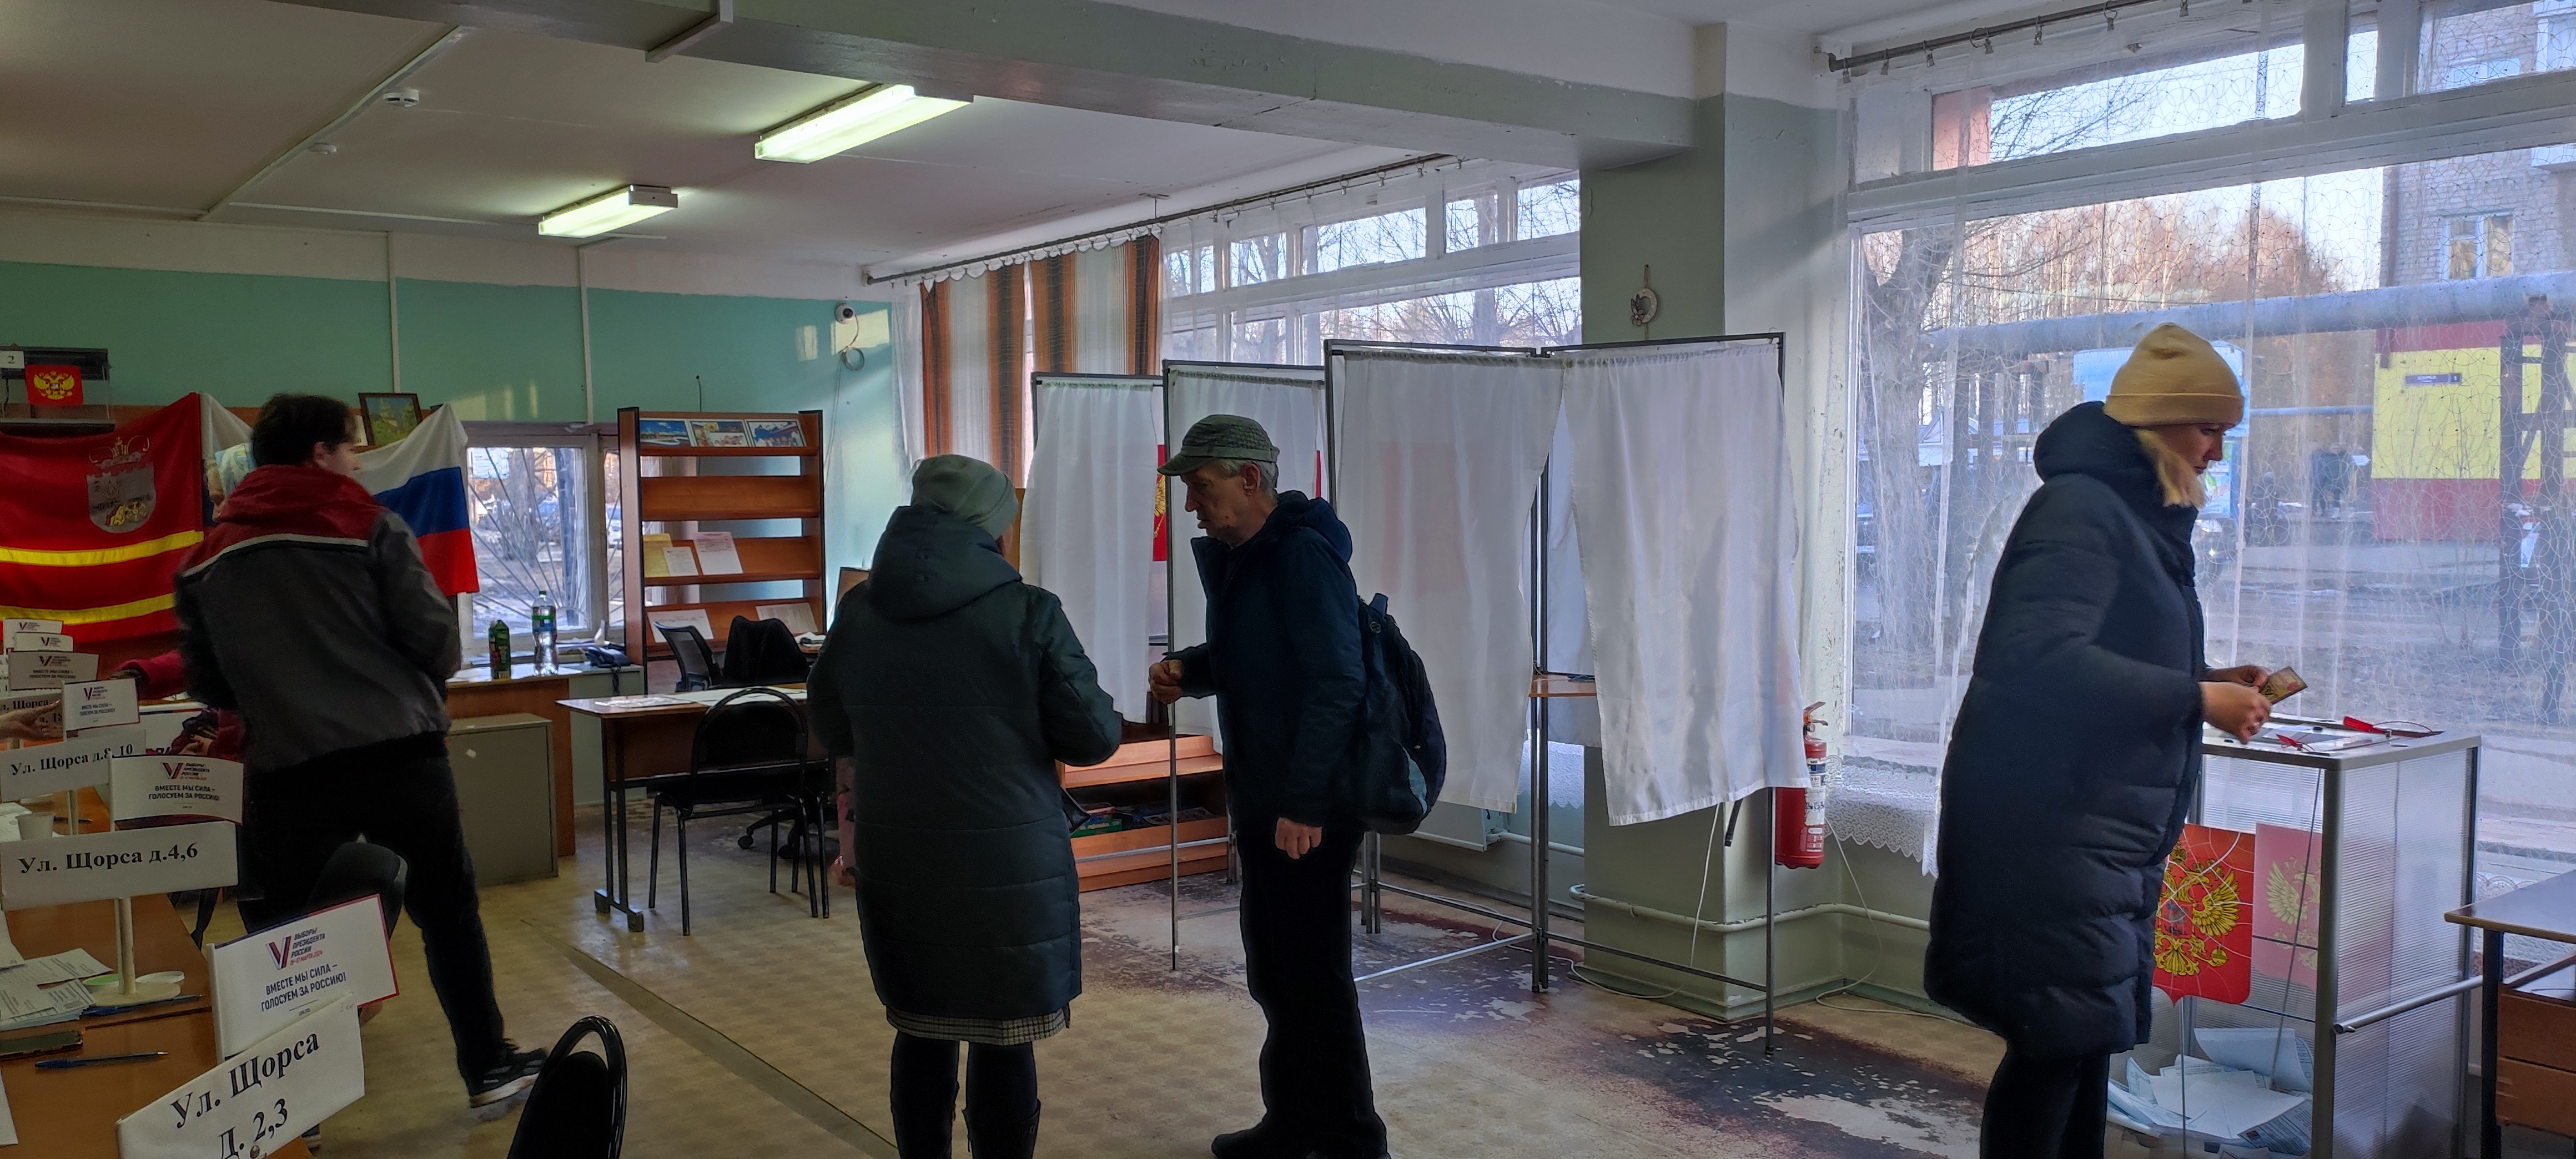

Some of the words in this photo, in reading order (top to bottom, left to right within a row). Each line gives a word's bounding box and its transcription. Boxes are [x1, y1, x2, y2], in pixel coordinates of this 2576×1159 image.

[8, 355, 15, 364] 2
[11, 763, 36, 775] Ул.
[41, 754, 88, 770] Щорса
[119, 744, 133, 756] 10
[18, 857, 57, 874] Ул.
[66, 851, 143, 870] Щорса
[149, 842, 198, 864] д.4,6
[292, 933, 325, 949] ПРЕЗИДЕНТА
[294, 927, 318, 940] ВЫБОРЫ
[291, 945, 312, 958] РОССИИ
[261, 989, 298, 1012] ГОЛОСУЕМ
[299, 985, 309, 996] ЗА
[310, 971, 346, 992] РОССИЮ!
[265, 976, 294, 995] ВМЕСТЕ
[294, 971, 309, 984] МЫ
[310, 964, 331, 979] СИЛА
[170, 1091, 221, 1129] Ул.
[228, 1033, 320, 1098] Щорса
[253, 1098, 288, 1142] 2,3
